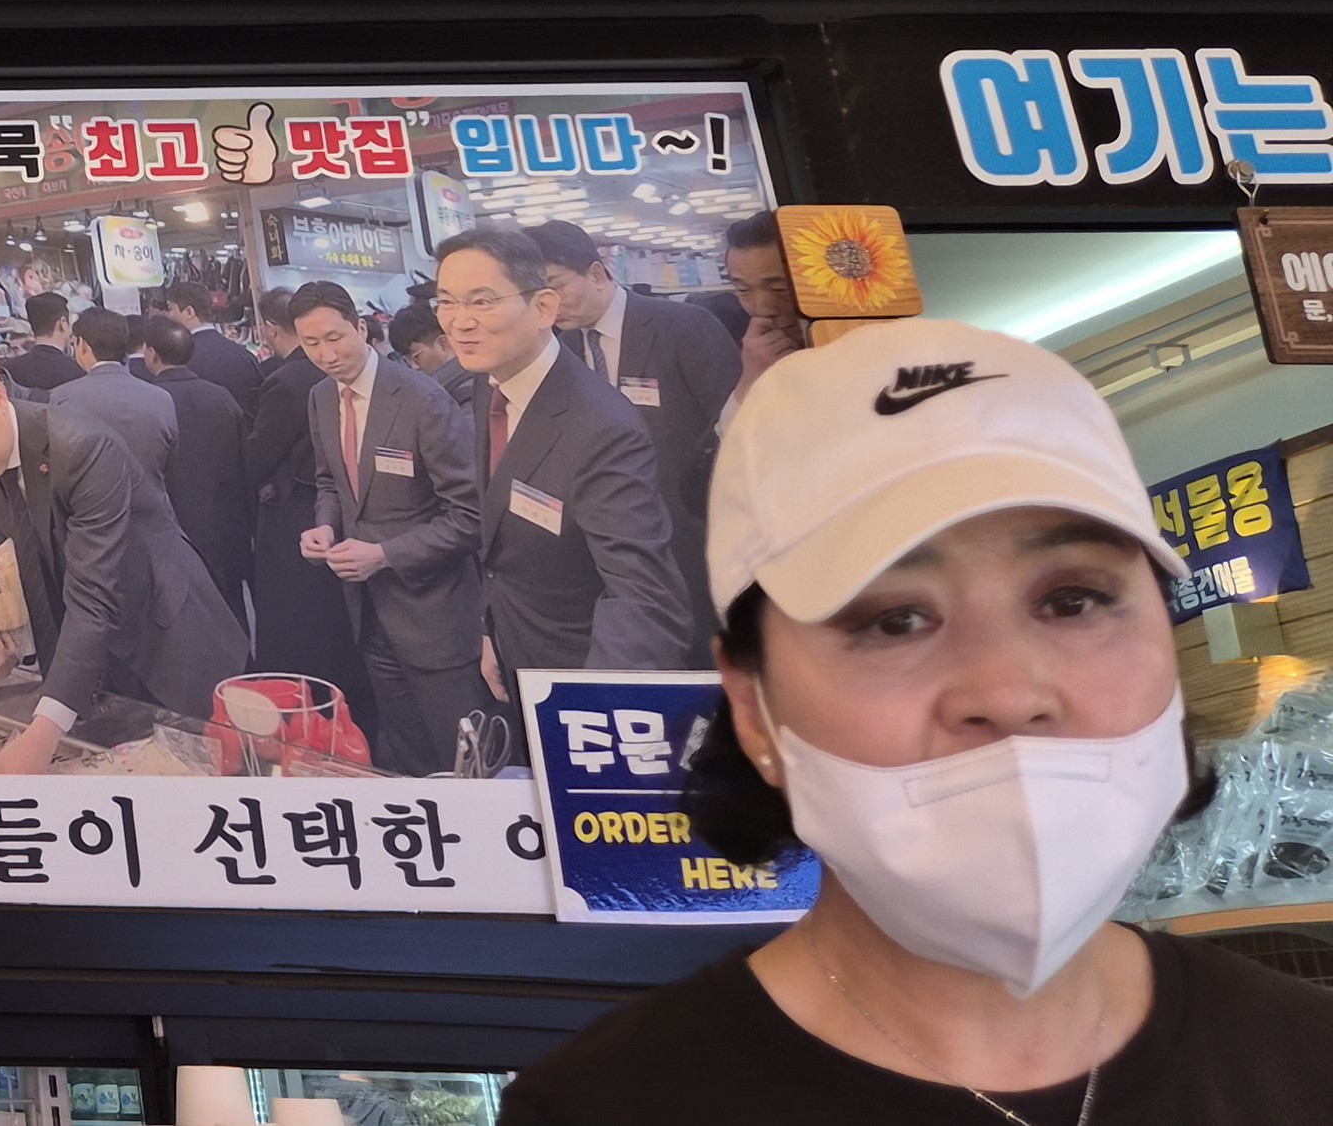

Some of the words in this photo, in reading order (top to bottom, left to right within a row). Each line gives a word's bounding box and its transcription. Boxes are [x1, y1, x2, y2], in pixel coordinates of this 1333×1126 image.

[940, 49, 1333, 185] 여기는
[1282, 252, 1333, 292] 에
[893, 361, 975, 391] NIKE
[558, 709, 672, 774] 주문
[195, 798, 458, 890] 선택한
[574, 812, 692, 844] ORDER
